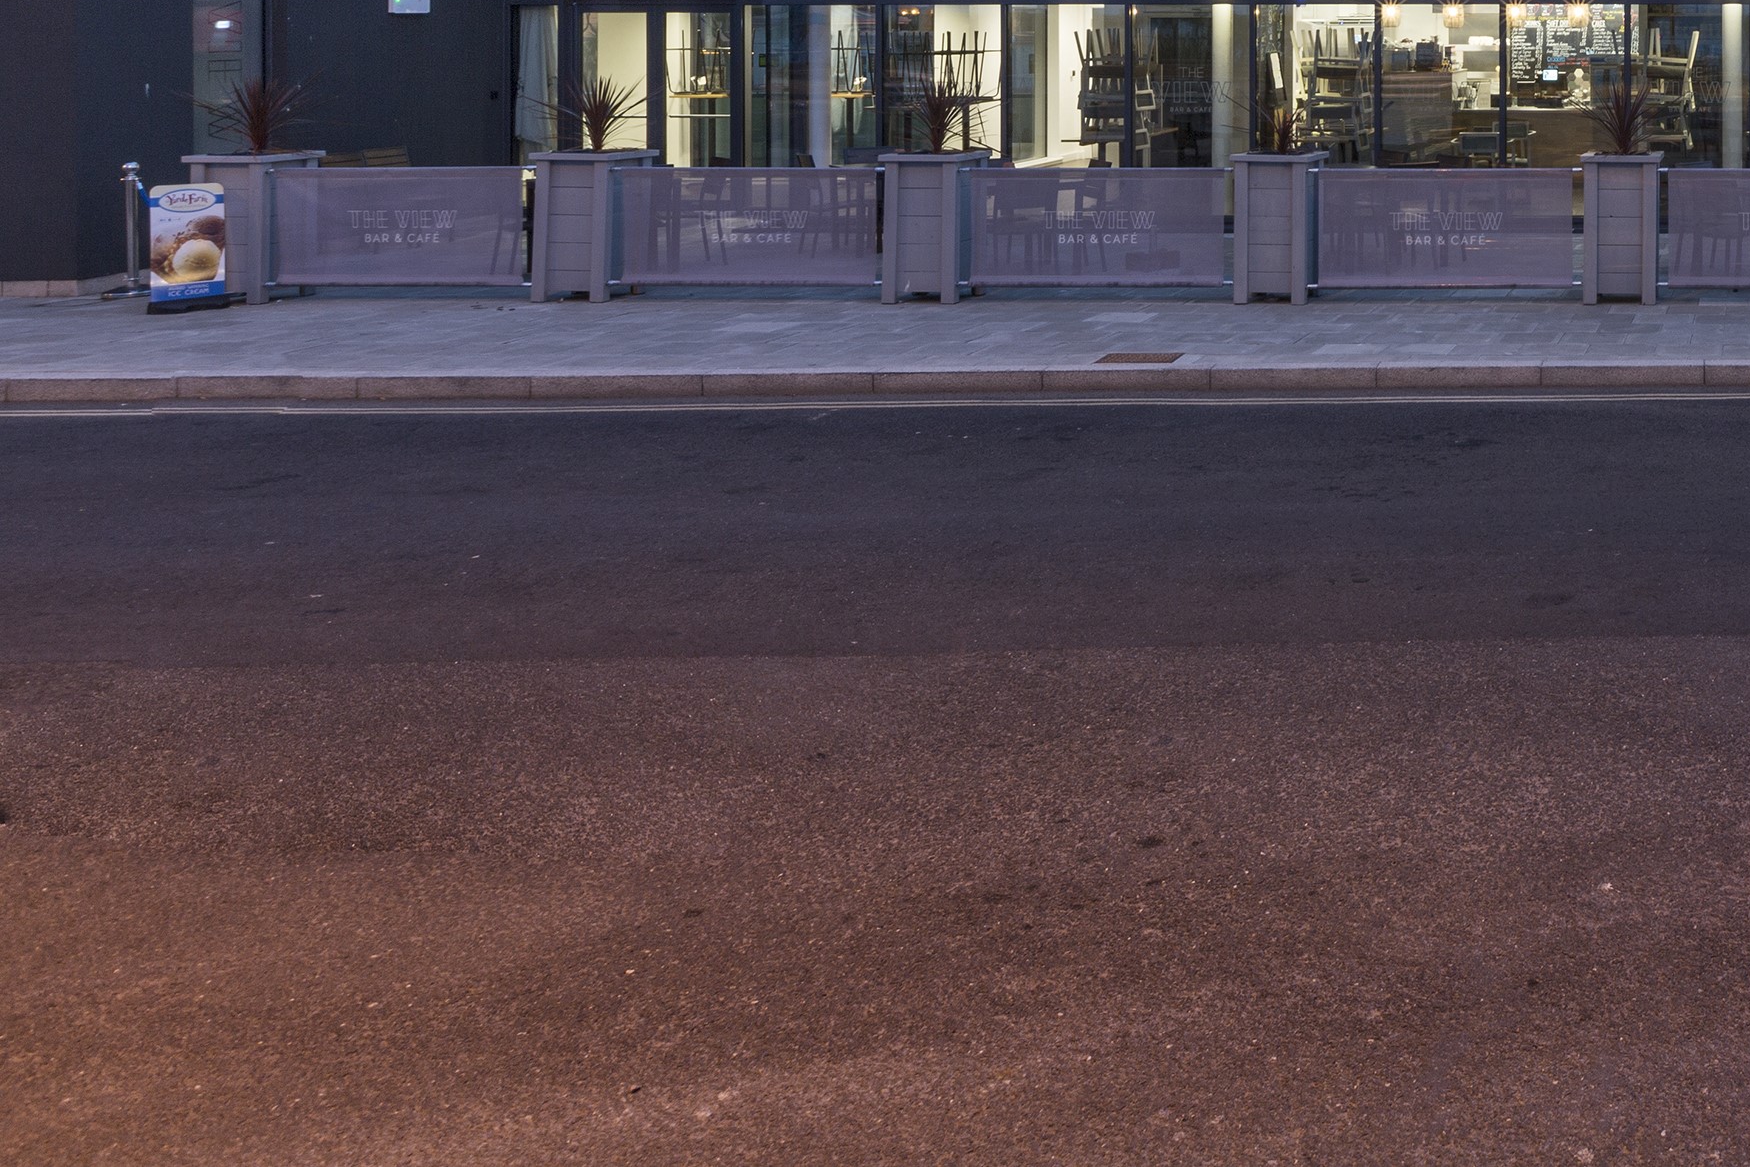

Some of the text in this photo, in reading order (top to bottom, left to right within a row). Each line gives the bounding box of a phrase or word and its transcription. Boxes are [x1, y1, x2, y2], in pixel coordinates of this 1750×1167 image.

[1179, 66, 1204, 78] THE
[1151, 80, 1231, 104] VIEW
[347, 209, 458, 229] THE VIEW
[1042, 210, 1156, 230] THE VIEW
[1388, 212, 1503, 231] THE VIEW
[364, 231, 440, 243] BAR & CAFÉ
[711, 231, 792, 243] BAR & CAFÉ
[1058, 232, 1138, 244] BAR & CAFÉ
[1406, 233, 1486, 246] BAR & CAFÉ
